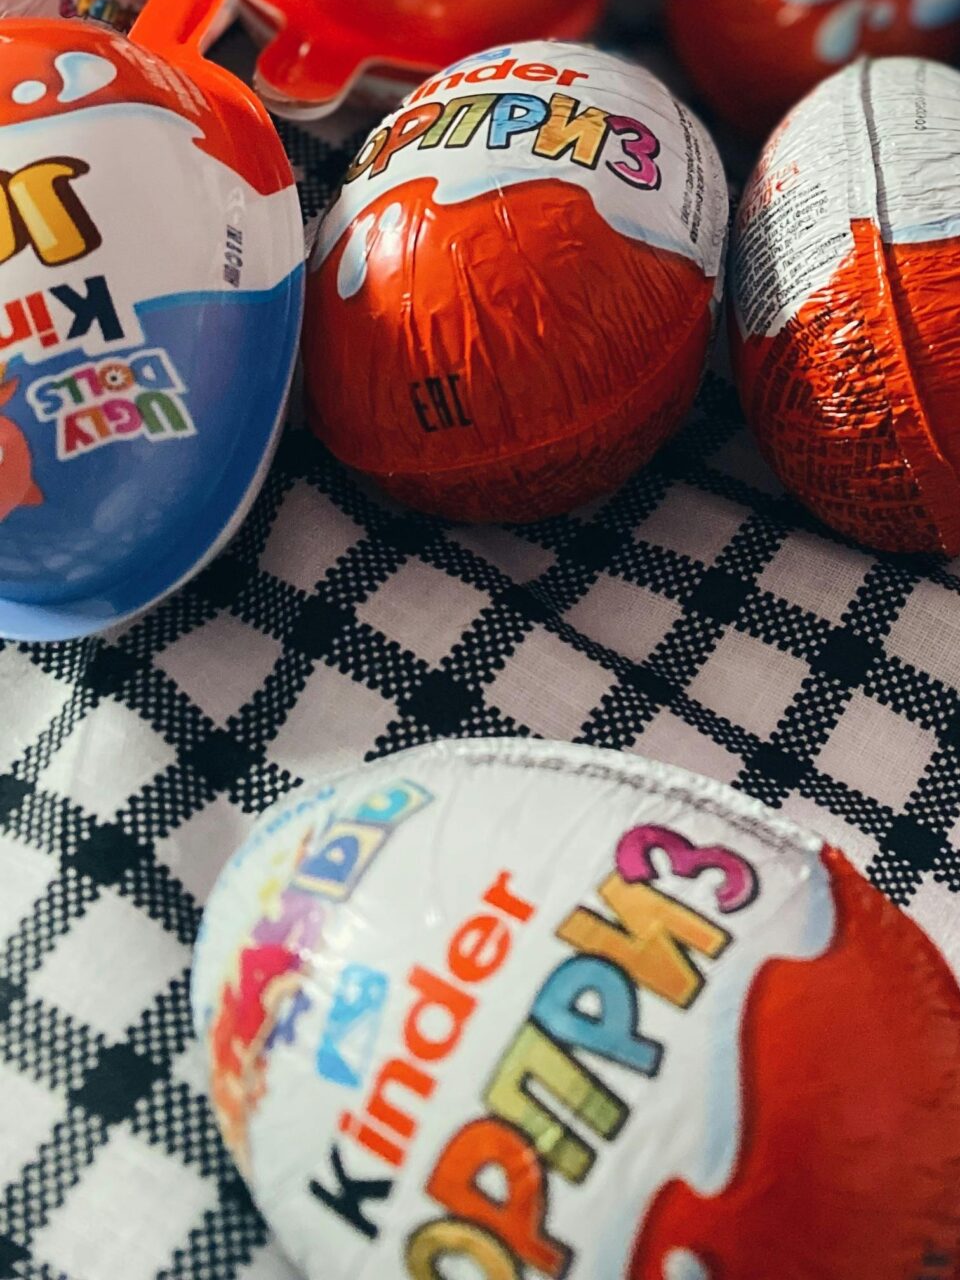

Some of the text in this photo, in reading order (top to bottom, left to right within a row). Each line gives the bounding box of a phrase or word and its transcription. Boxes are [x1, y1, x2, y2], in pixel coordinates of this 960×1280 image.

[409, 58, 589, 103] inder
[346, 91, 661, 190] РПРИЗ
[0, 275, 125, 349] Kin
[35, 355, 174, 417] DOLLS
[62, 391, 188, 454] UGLY
[308, 869, 538, 1241] Kinder
[402, 822, 760, 1280] РПРИЗ
